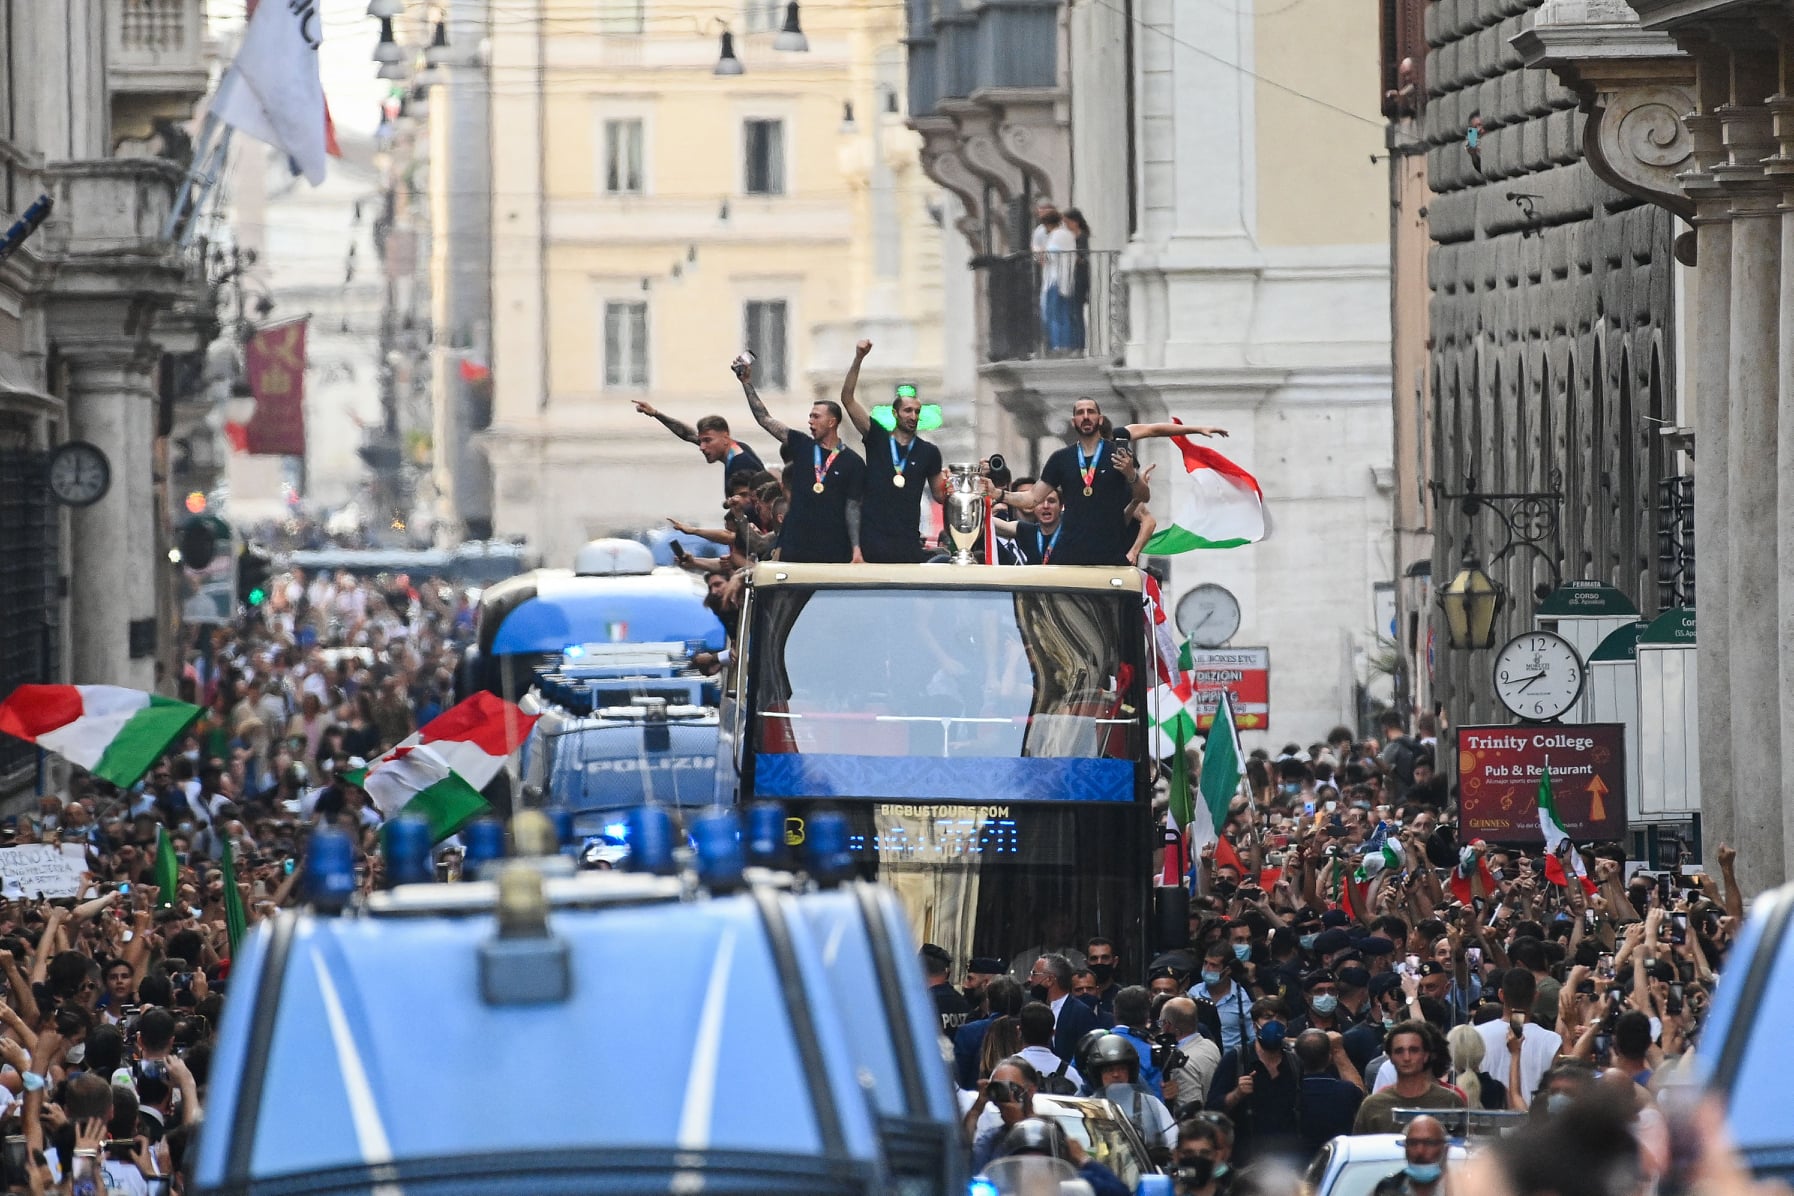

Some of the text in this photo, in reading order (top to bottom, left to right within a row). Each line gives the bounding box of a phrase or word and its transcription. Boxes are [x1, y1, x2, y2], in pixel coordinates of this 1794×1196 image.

[1572, 581, 1601, 589] FERMATA
[1574, 592, 1600, 600] CORSO
[1531, 637, 1546, 652] 12
[1500, 670, 1509, 685] 9
[1567, 668, 1577, 682] 3
[1534, 700, 1544, 714] 6
[1468, 734, 1594, 751] Trinity College
[1485, 765, 1508, 777] Pub
[1512, 765, 1523, 776] &
[880, 804, 1009, 818] BIGBUSTOURS.COM
[1469, 818, 1510, 828] GUINNESS
